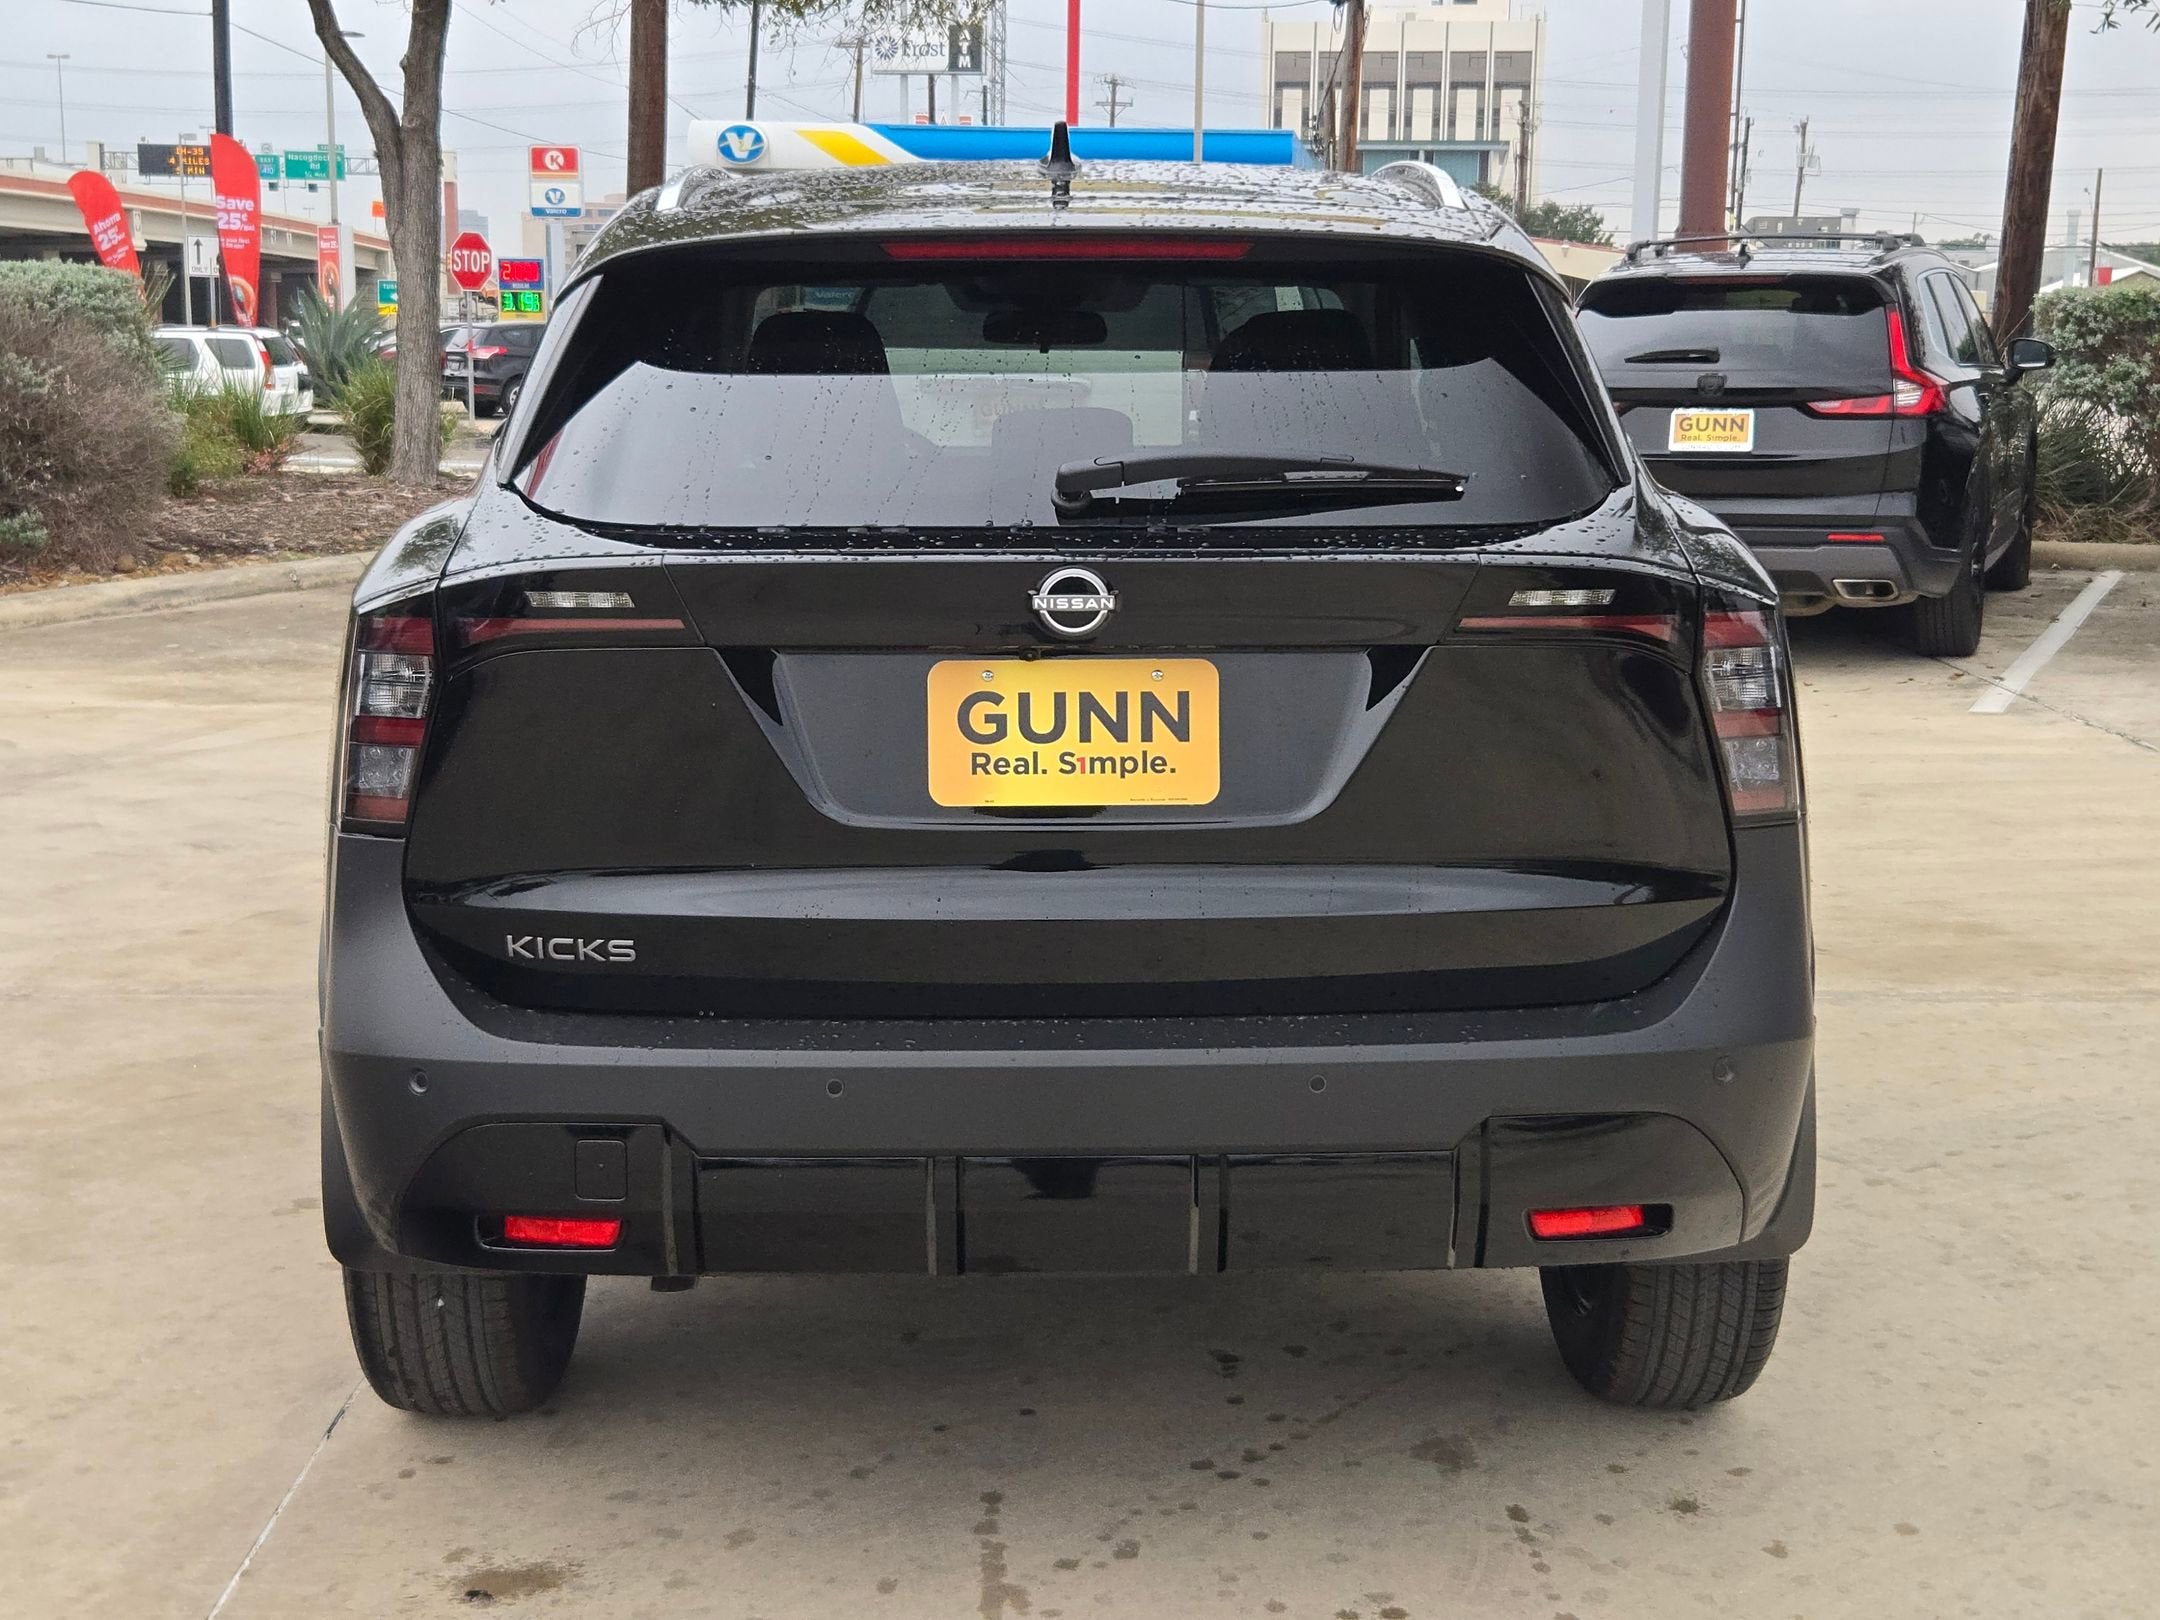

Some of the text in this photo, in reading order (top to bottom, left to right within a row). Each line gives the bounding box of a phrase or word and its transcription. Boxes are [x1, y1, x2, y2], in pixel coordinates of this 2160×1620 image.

[310, 162, 320, 170] Rd
[216, 195, 255, 212] Save
[453, 249, 490, 273] STOP
[1680, 417, 1745, 433] GUNN
[1681, 434, 1703, 442] Real.
[1034, 598, 1114, 609] NISSAN
[957, 690, 1190, 744] GUNN
[971, 751, 1047, 775] Real.
[506, 935, 637, 961] KICKS
